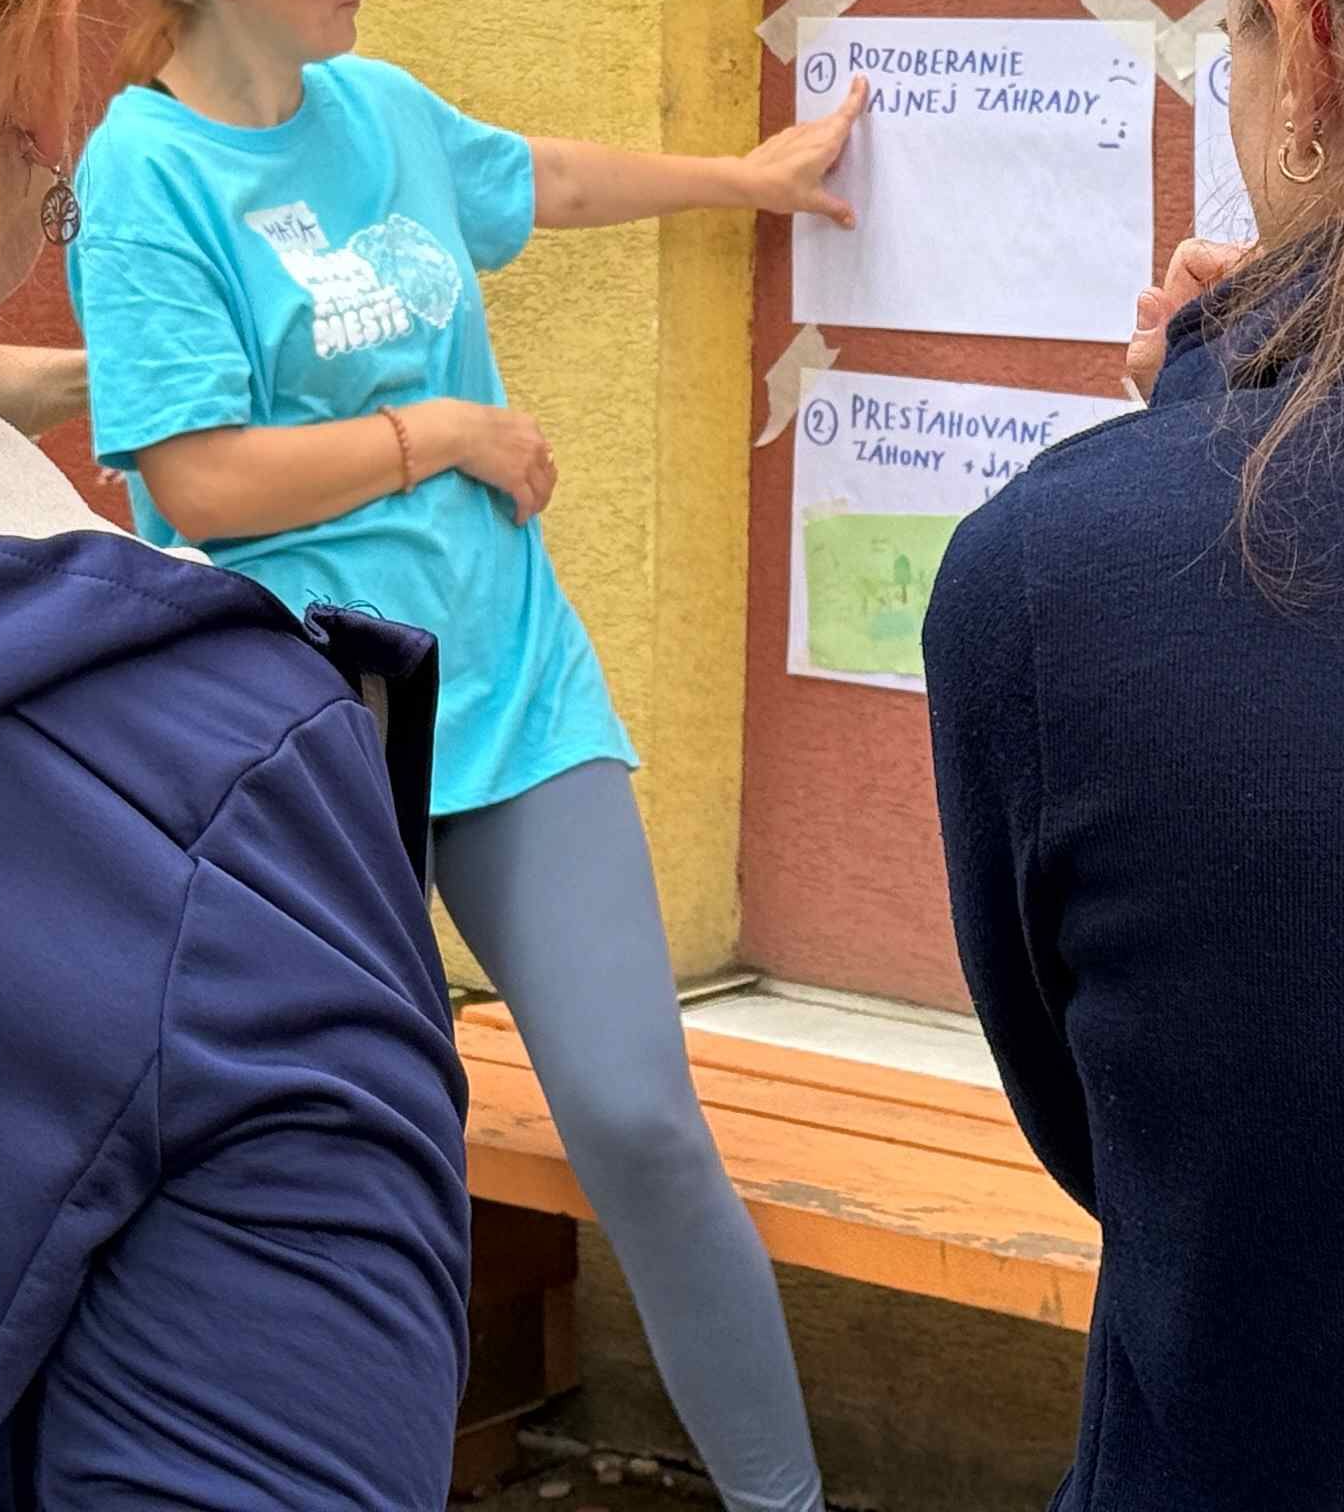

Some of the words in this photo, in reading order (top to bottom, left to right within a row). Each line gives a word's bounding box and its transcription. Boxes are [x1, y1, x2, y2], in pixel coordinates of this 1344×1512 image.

[849, 41, 1024, 77] ROZOBERANIE
[867, 81, 957, 117] AJNEJ
[975, 82, 1102, 116] ZÁHRADY
[851, 393, 1061, 446] PRESŤAHOVANÉ
[854, 437, 947, 473] ZÁHONY
